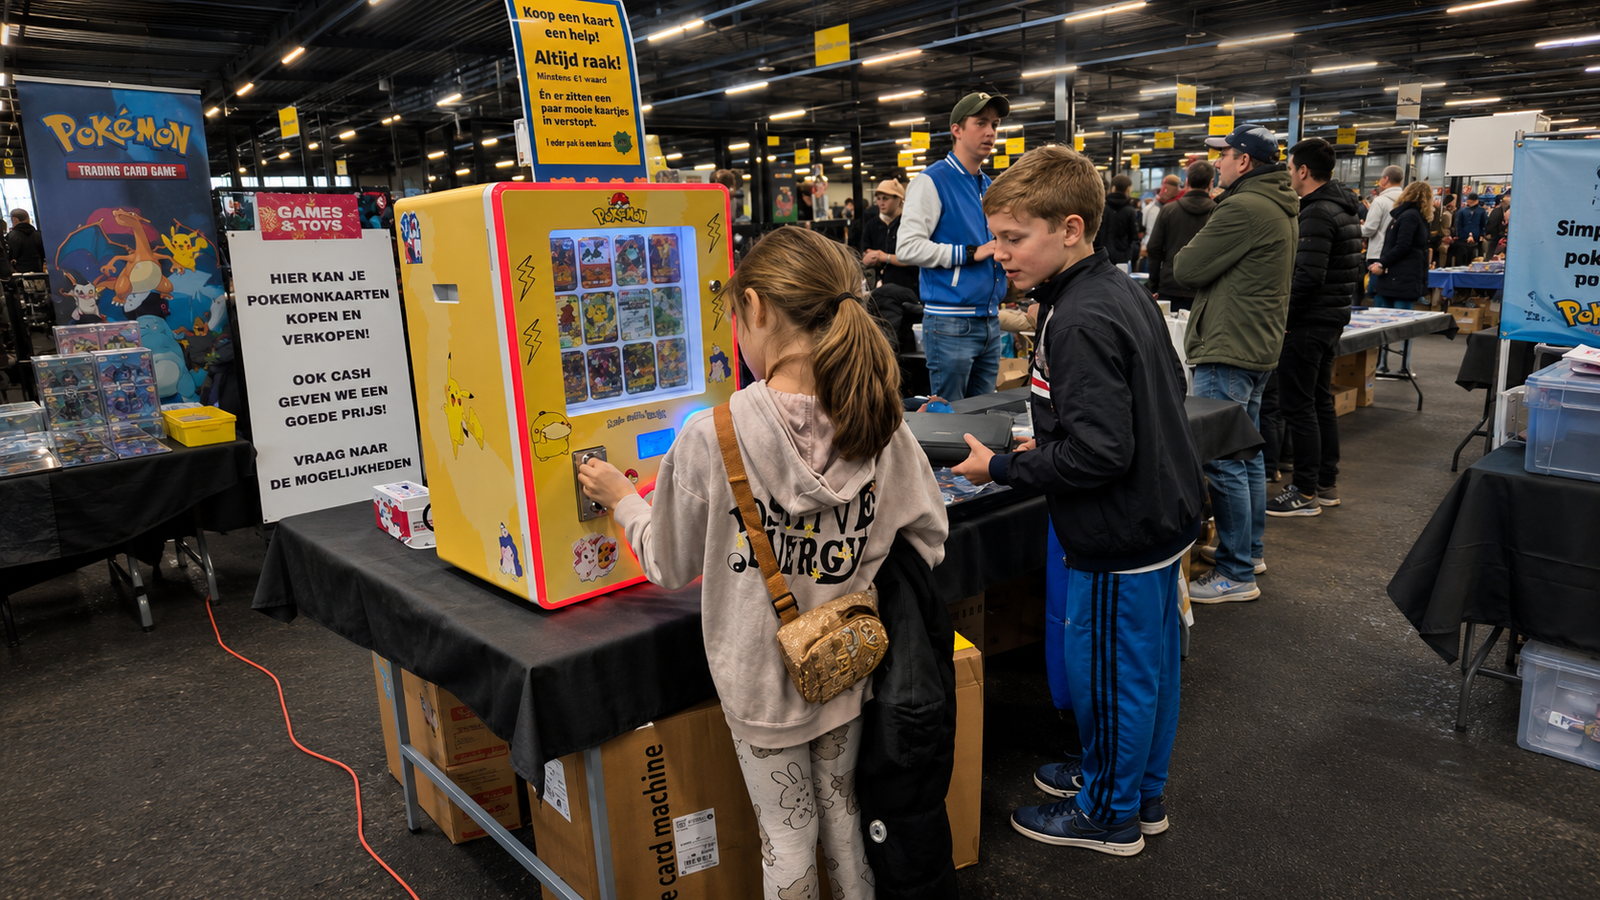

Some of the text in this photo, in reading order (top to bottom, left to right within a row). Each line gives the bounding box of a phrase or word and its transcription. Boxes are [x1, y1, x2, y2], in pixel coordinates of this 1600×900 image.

[523, 6, 615, 28] Koop een kaart
[545, 28, 600, 45] een help!
[534, 50, 622, 70] Altijd raak!
[536, 72, 607, 84] Minstens €1 waard
[539, 88, 612, 103] Én er zitten een
[541, 104, 630, 118] paar mooie kaartjes
[542, 116, 597, 128] in verstopt.
[566, 140, 578, 148] pak
[579, 140, 585, 148] is
[586, 140, 597, 148] een
[598, 140, 612, 148] kans
[78, 165, 177, 177] TRADING CARD GAME
[277, 206, 343, 219] GAMES
[281, 220, 343, 231] & TOYS
[1564, 249, 1600, 268] pok
[270, 270, 366, 284] HIER KAN JE
[246, 289, 390, 306] POKEMONKAARTEN
[286, 310, 362, 324] KOPEN EN
[282, 329, 370, 345] VERKOPEN!
[293, 368, 371, 386] OOK CASH
[278, 386, 388, 407] GEVEN WE EEN
[285, 404, 387, 427] GOEDE PRIJS!
[293, 443, 388, 466] VRAAG NAAR
[270, 458, 412, 490] DE MOGELIJKHEDEN
[641, 744, 672, 837] machine
[649, 840, 677, 886] card
